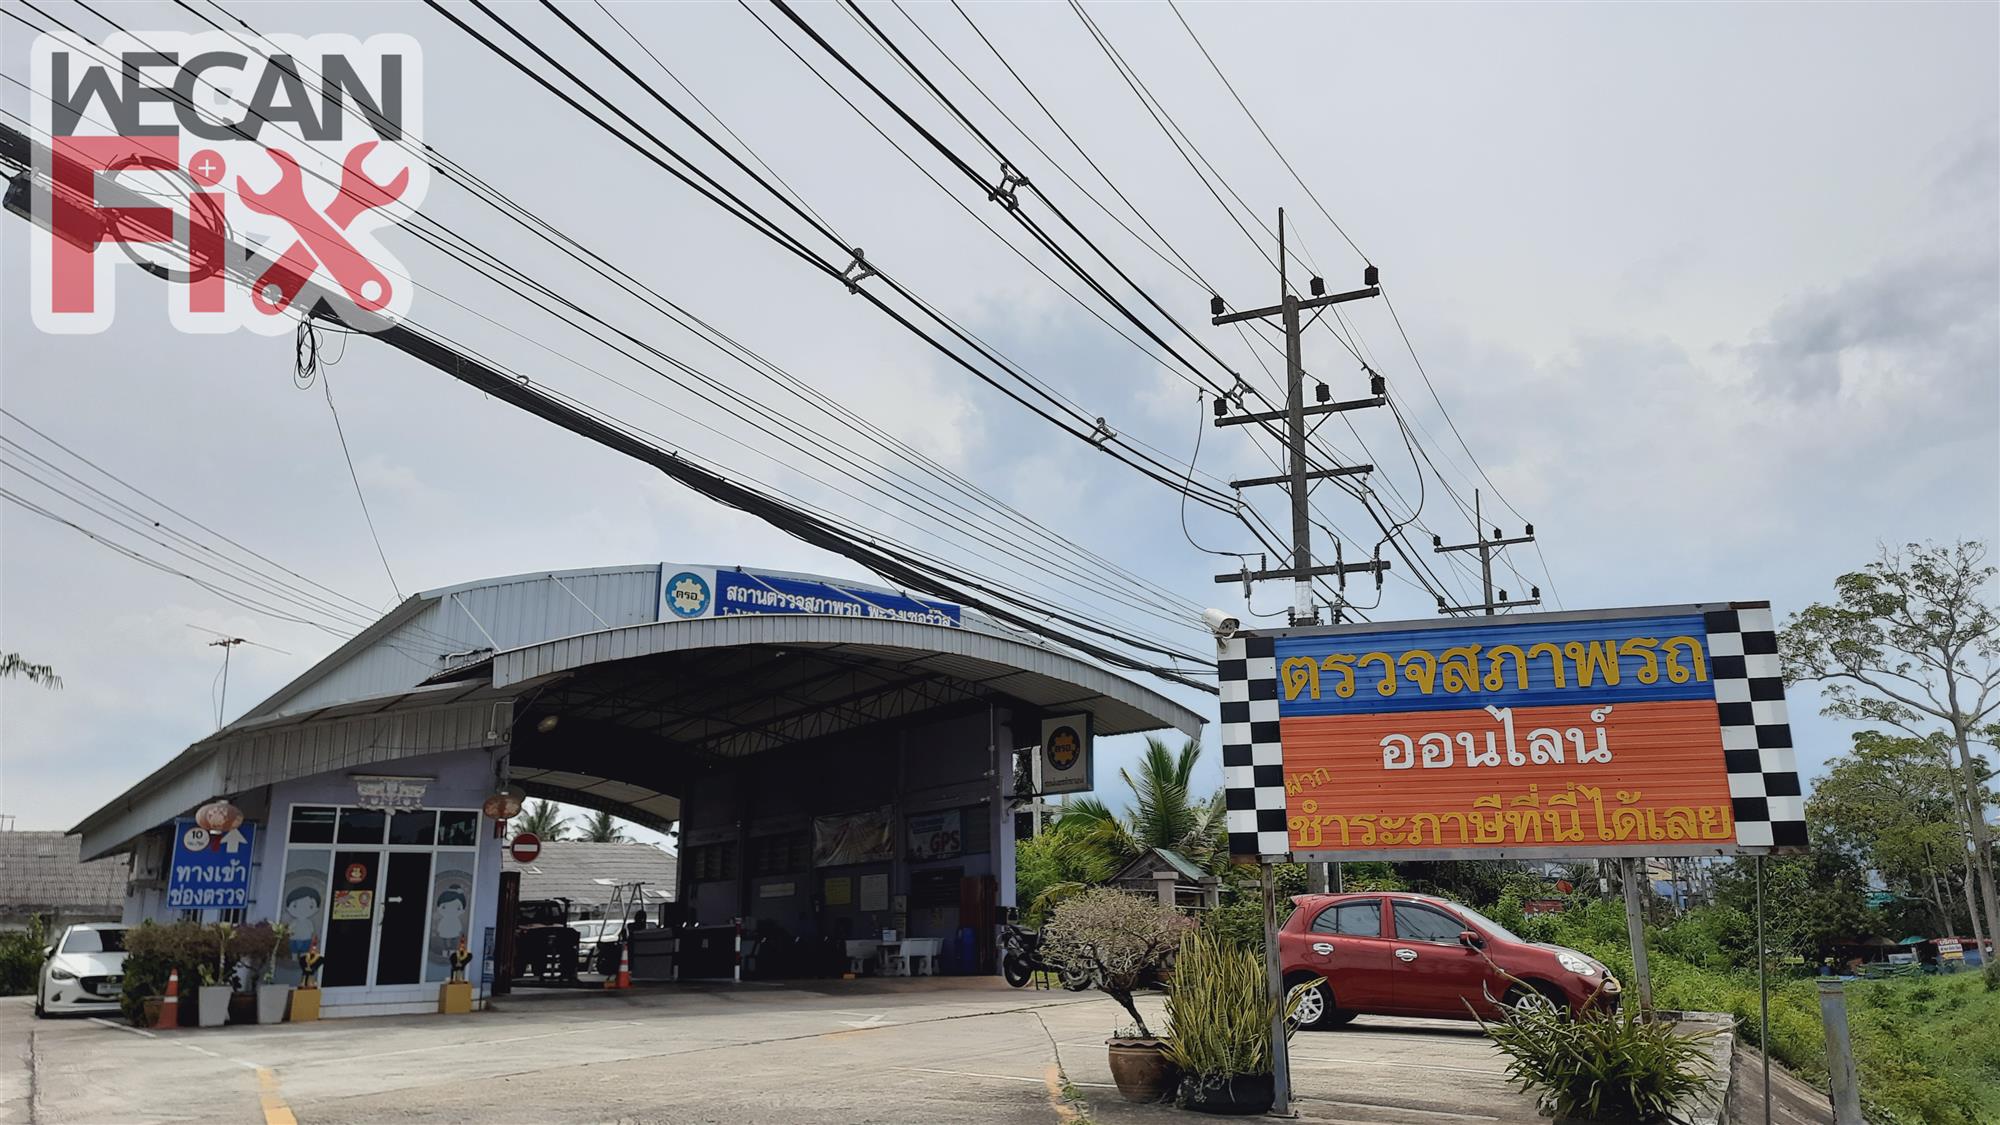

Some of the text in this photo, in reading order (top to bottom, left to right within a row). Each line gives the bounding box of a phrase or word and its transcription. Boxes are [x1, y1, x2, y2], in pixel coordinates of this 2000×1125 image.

[1280, 635, 1707, 700] ตรวจสภาพรถ
[1379, 704, 1614, 770] ออนไลน์
[1285, 767, 1332, 797] ฝาก
[1288, 782, 1732, 847] ชำระภาษีที่นี่ได้เลย
[192, 830, 203, 840] 10
[930, 830, 960, 853] GPS
[176, 859, 246, 882] ทางเข้า
[170, 884, 246, 906] ช่องตรวจ
